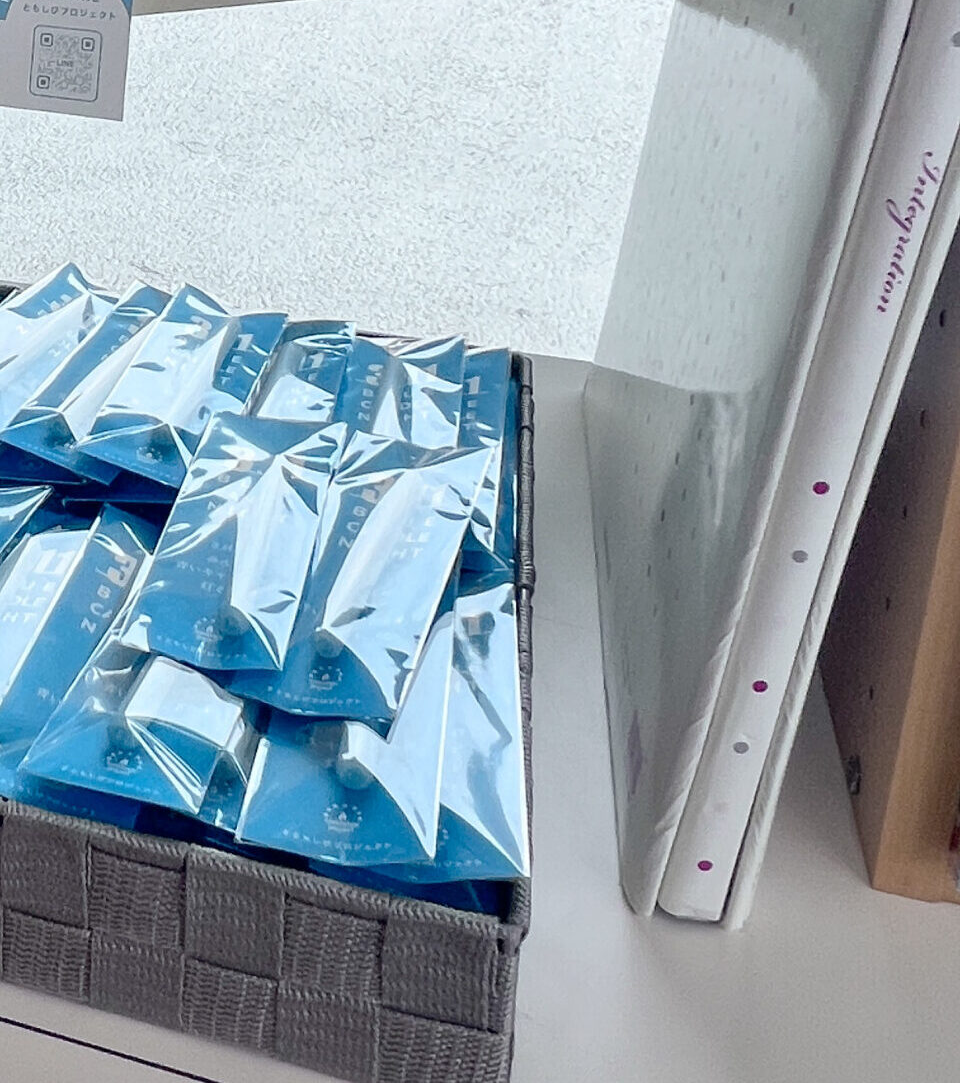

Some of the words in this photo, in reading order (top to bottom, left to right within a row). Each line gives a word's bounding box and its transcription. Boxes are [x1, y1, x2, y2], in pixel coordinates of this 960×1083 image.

[23, 3, 117, 20] ともしびプロジェクト
[876, 150, 941, 313] Integration
